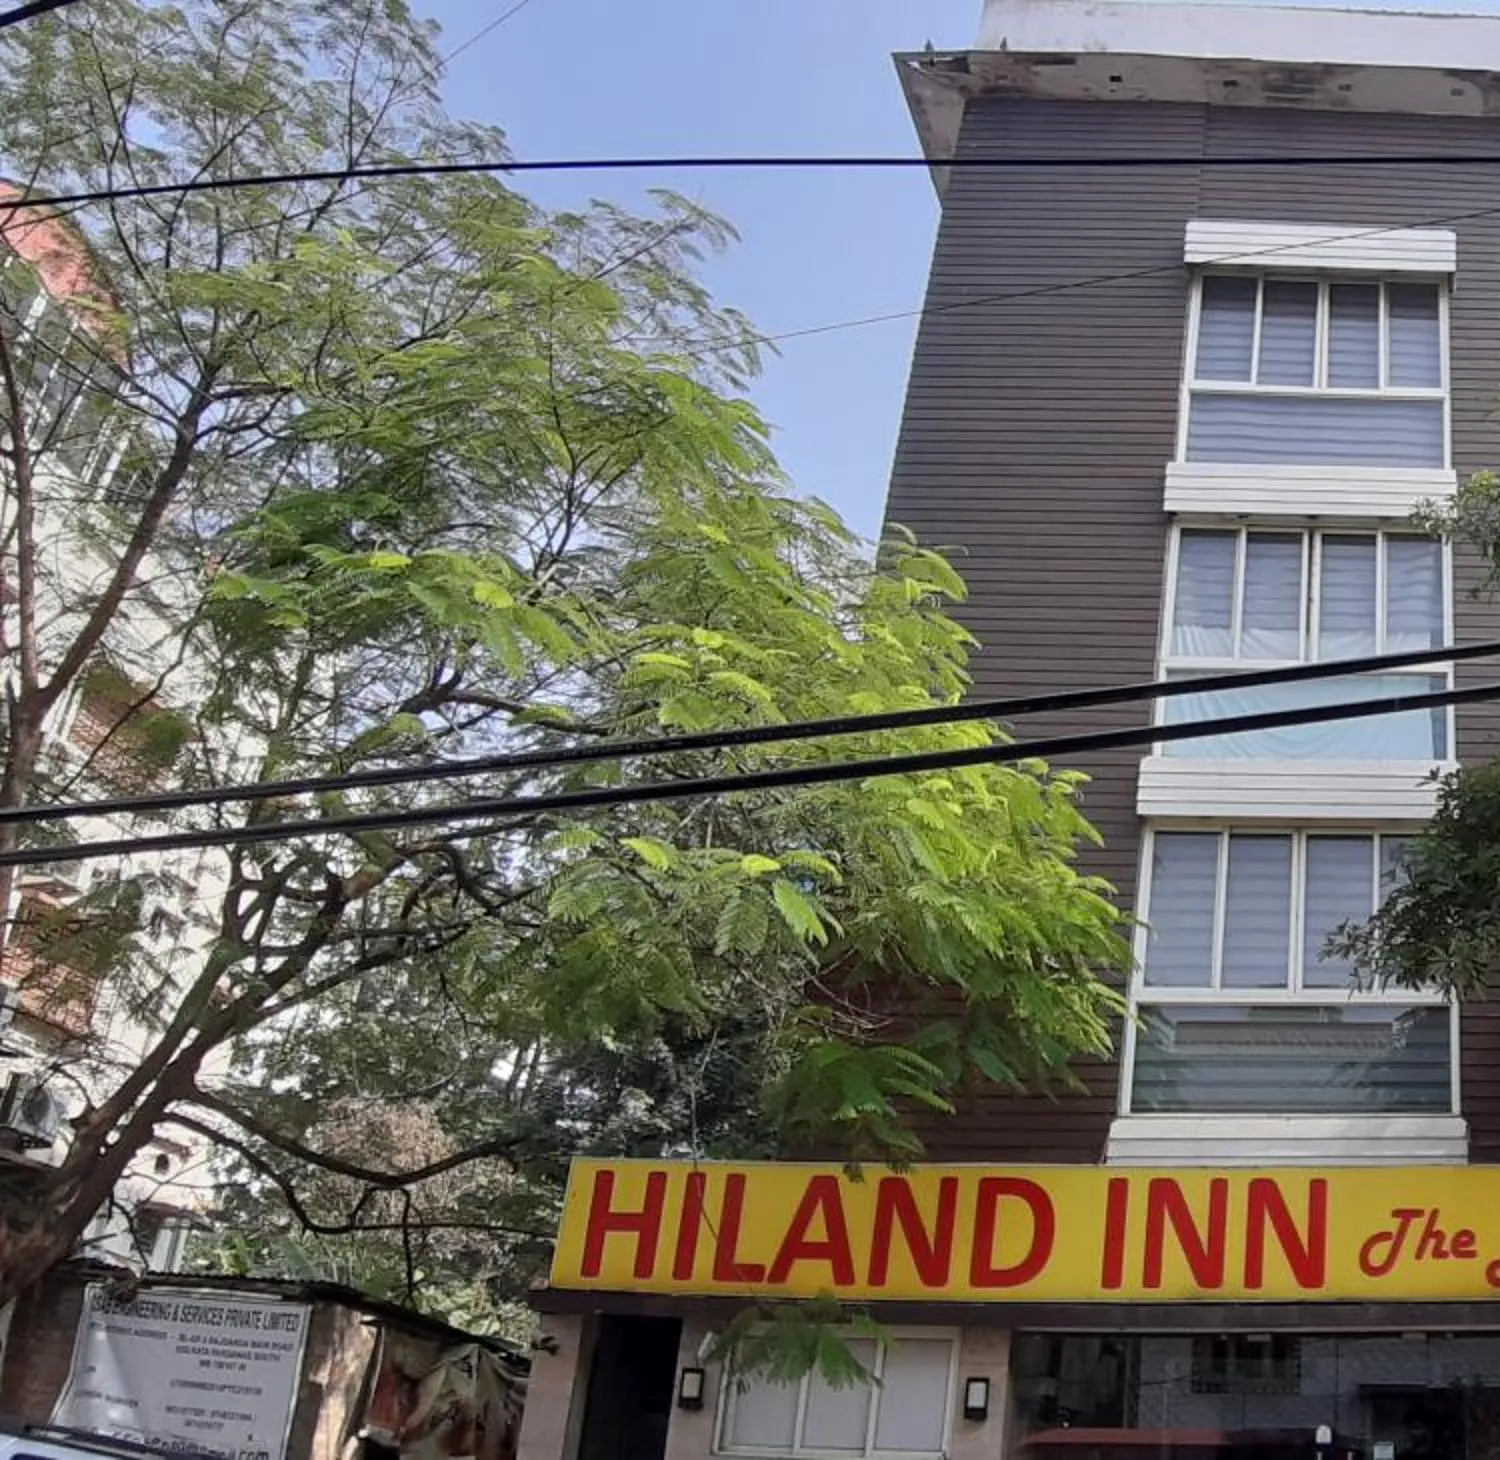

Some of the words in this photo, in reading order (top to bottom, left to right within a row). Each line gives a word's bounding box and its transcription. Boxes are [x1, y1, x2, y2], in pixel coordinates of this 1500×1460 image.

[580, 1169, 1056, 1289] HILAND
[1100, 1177, 1328, 1290] INN
[1358, 1208, 1478, 1277] The
[180, 1304, 223, 1326] SERVICES
[225, 1308, 261, 1329] PRIVATE
[262, 1311, 299, 1332] LIMITED
